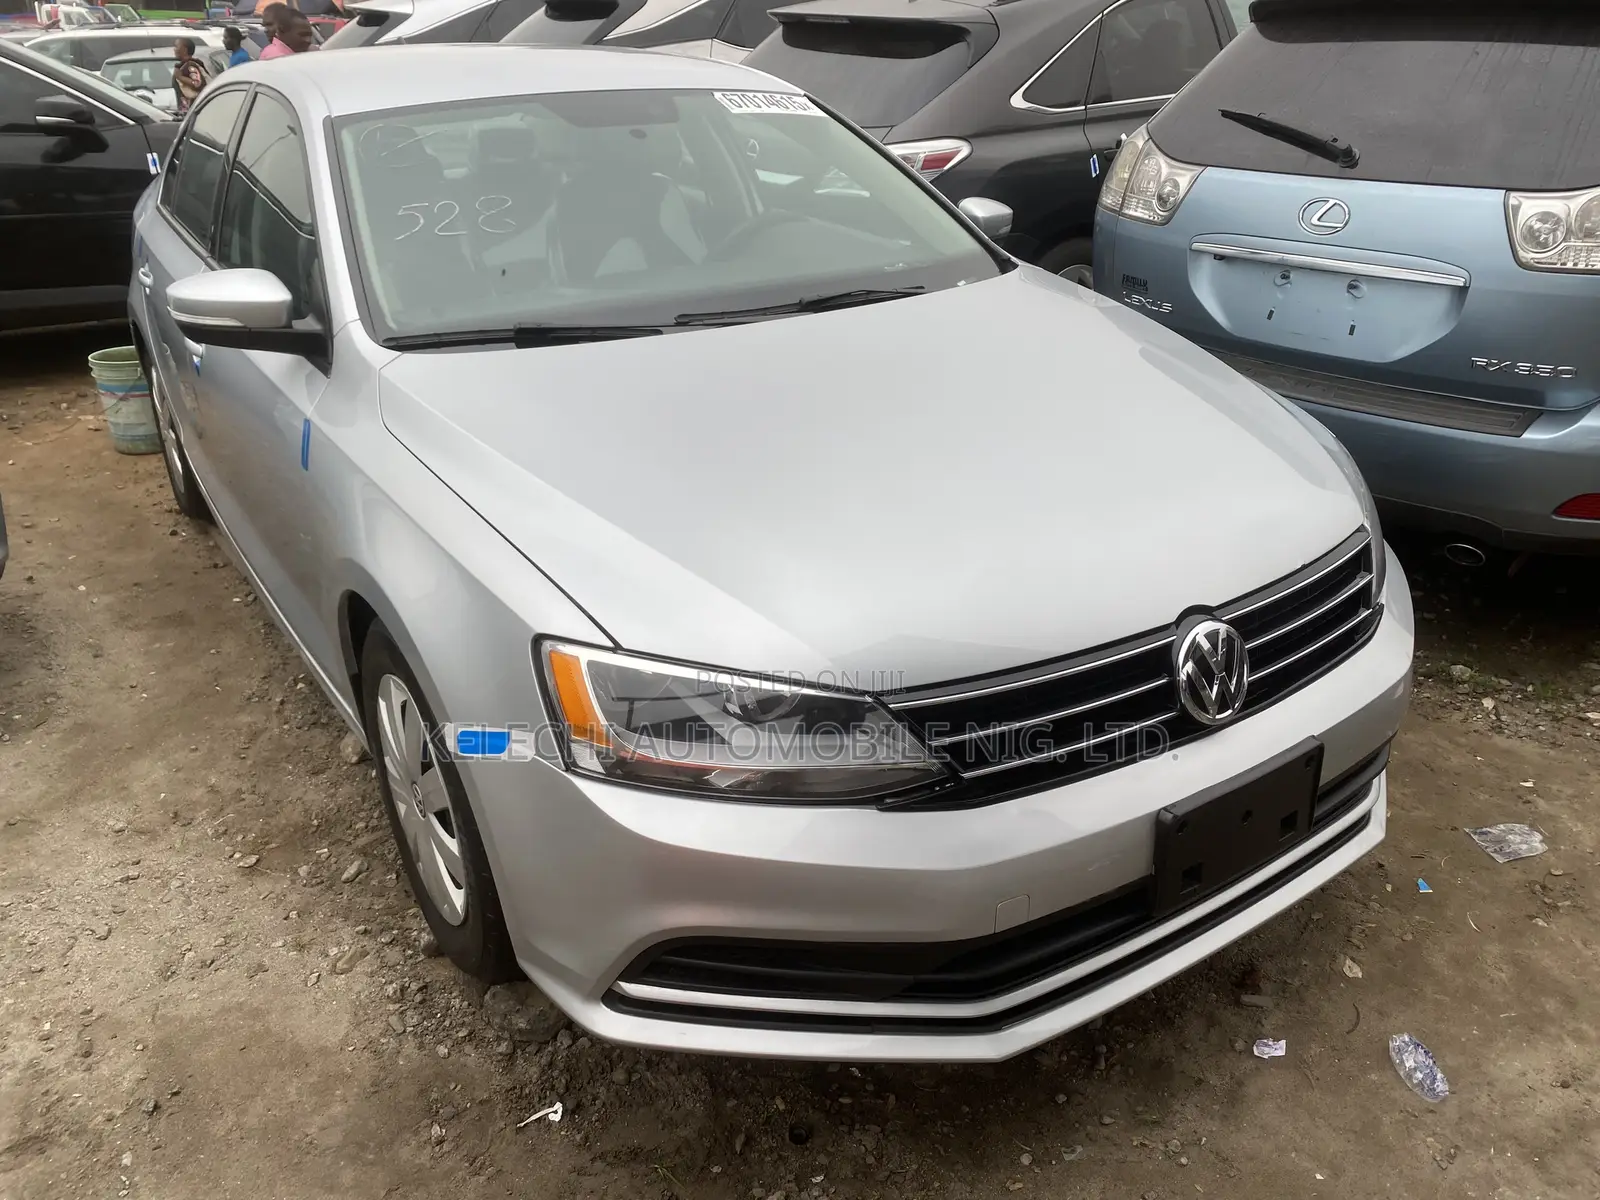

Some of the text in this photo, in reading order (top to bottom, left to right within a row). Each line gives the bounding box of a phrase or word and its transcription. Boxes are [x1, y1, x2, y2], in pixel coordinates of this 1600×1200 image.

[394, 195, 517, 241] 528
[1122, 290, 1173, 313] LEXUS
[1470, 356, 1512, 373] RX
